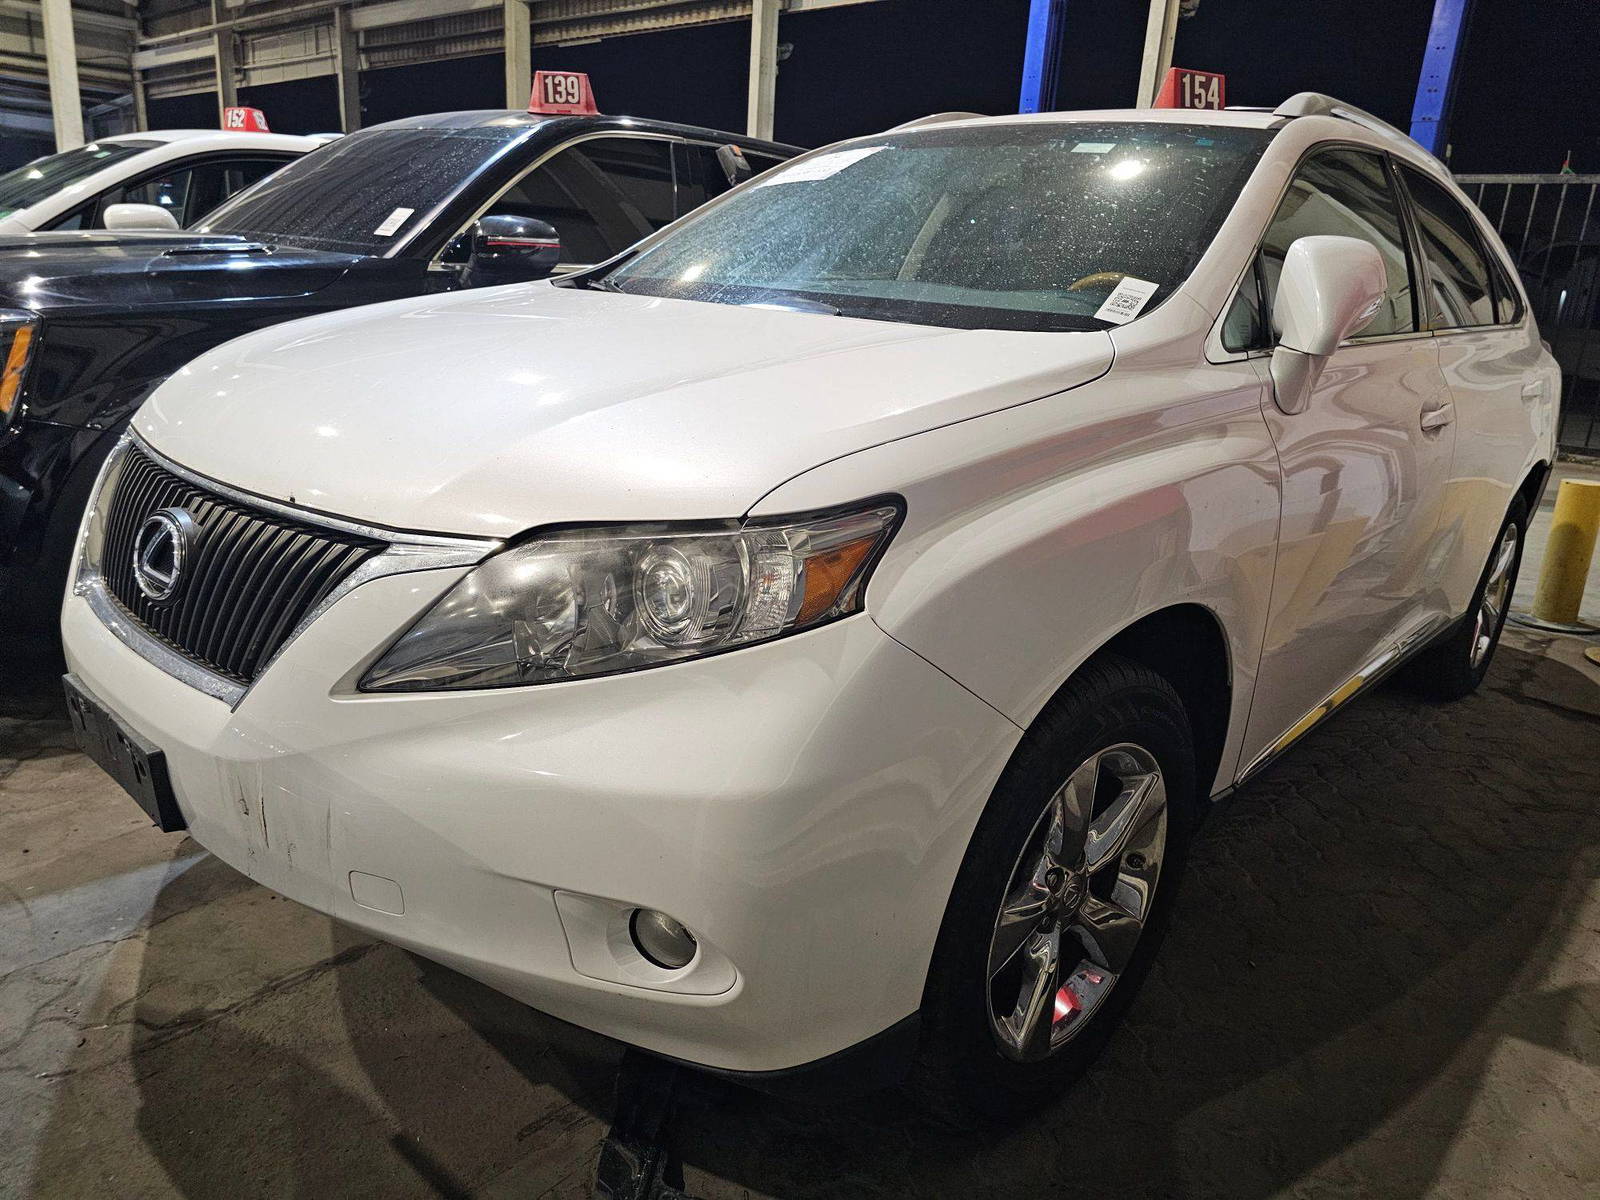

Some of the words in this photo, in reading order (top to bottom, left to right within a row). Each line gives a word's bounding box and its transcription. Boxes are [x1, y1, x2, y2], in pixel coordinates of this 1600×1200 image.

[545, 75, 580, 104] 139
[1182, 73, 1220, 110] 154
[226, 109, 246, 128] 152
